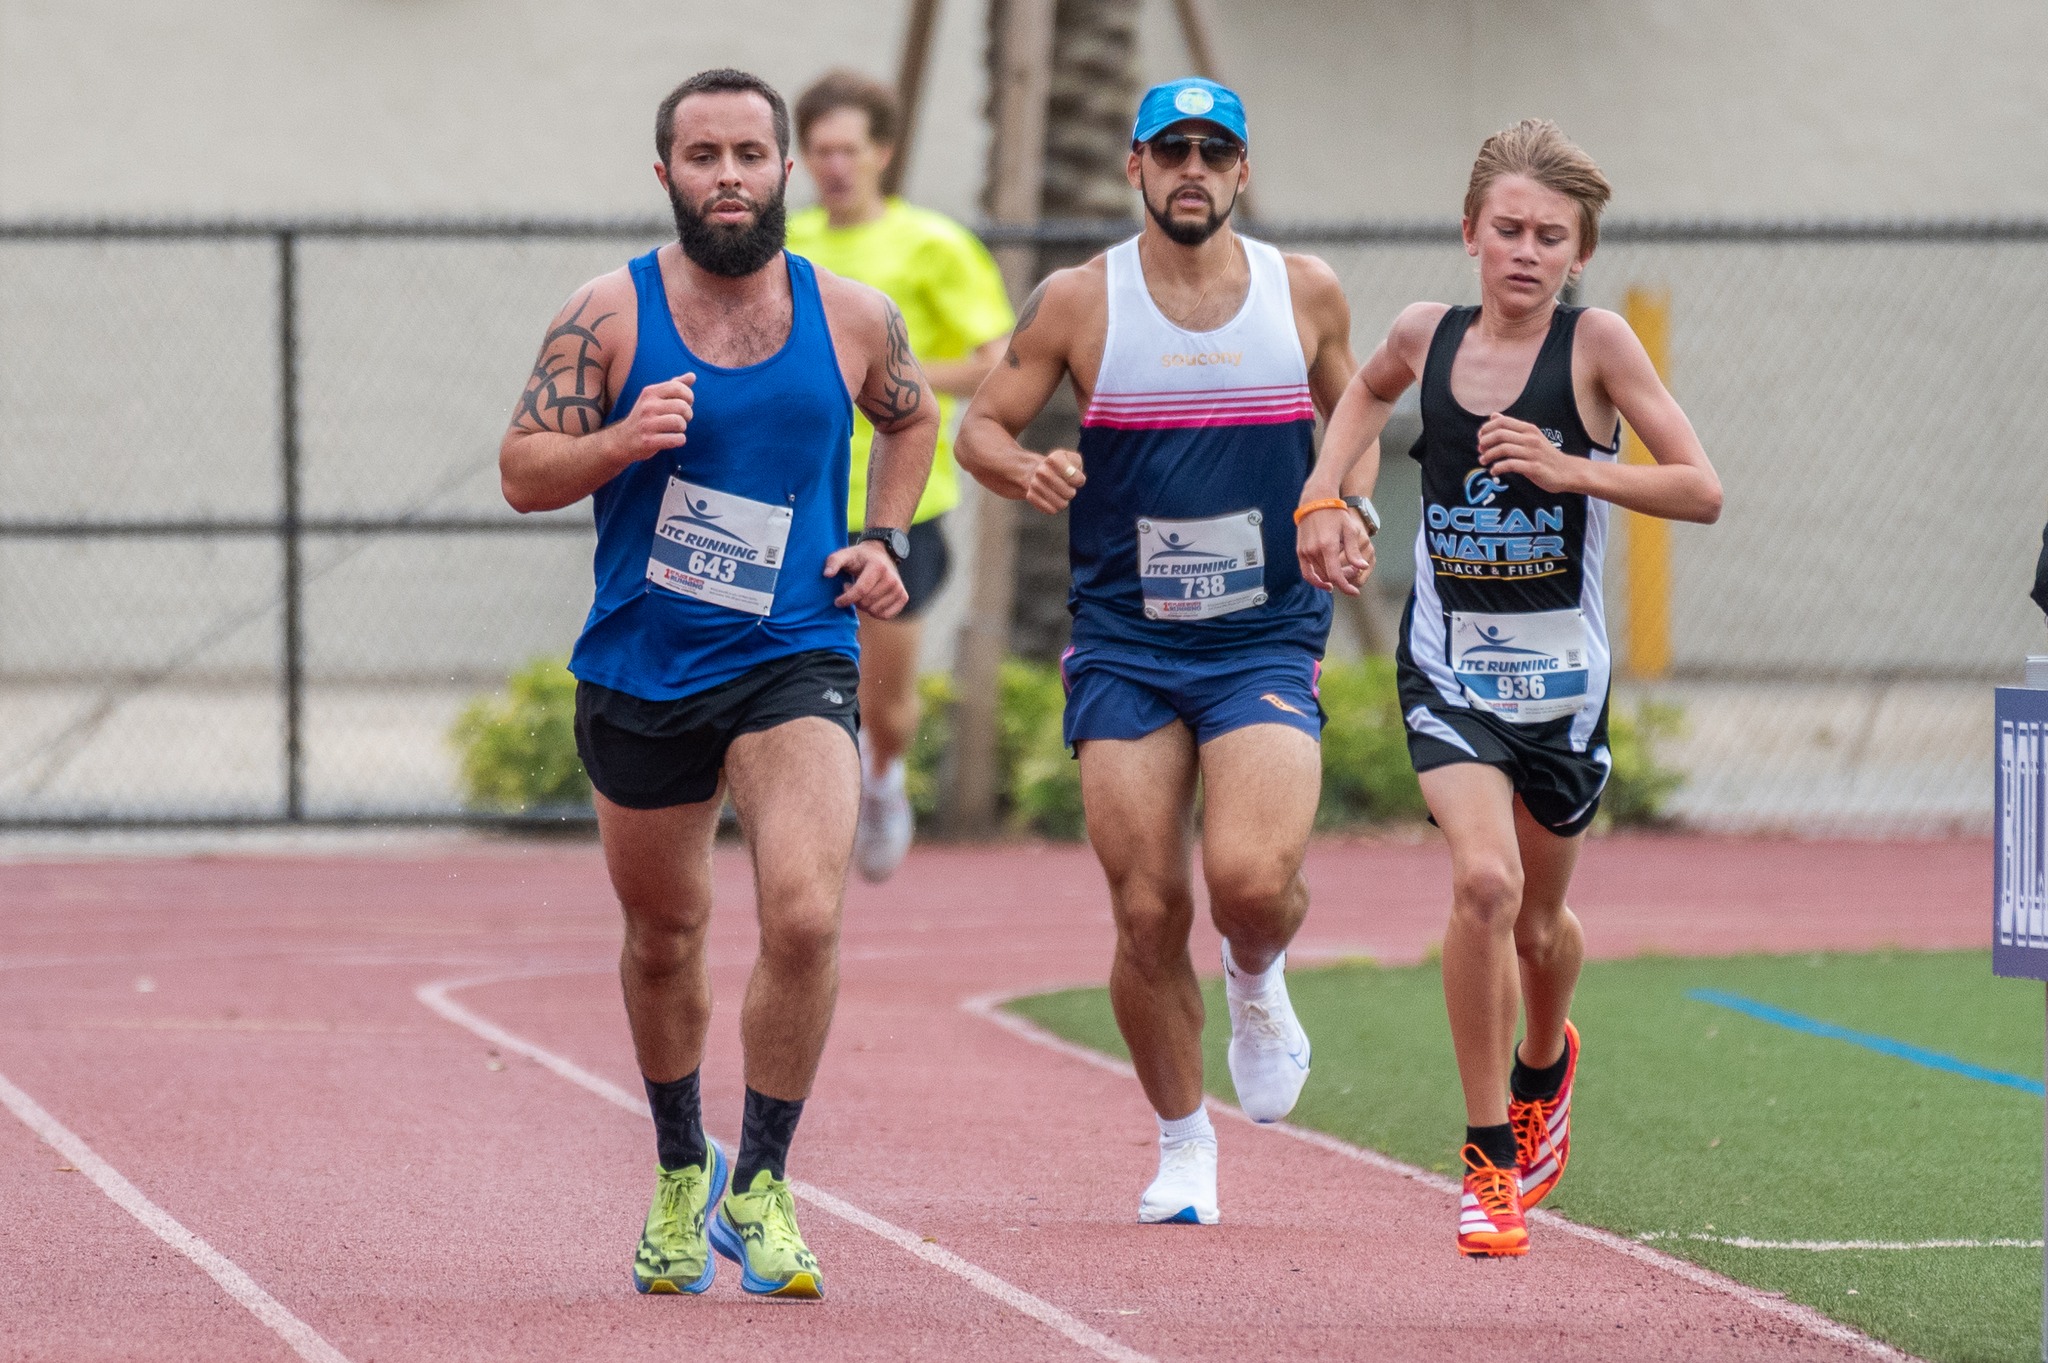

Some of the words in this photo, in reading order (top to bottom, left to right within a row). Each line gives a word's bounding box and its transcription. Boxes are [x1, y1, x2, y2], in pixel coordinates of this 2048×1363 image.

[1161, 351, 1243, 368] saucony
[1427, 503, 1564, 533] OCEAN
[659, 524, 685, 541] JTC
[684, 533, 759, 561] RUNNING
[1428, 531, 1565, 562] WATER
[688, 551, 738, 583] 643
[1145, 564, 1168, 575] JTC
[1171, 558, 1238, 575] RUNNING
[1442, 561, 1482, 575] TRACK
[1491, 566, 1499, 575] &
[1508, 562, 1554, 575] FIELD
[1180, 574, 1226, 599] 738
[1458, 659, 1485, 672] JTC
[1487, 658, 1559, 673] RUNNING
[1497, 675, 1546, 700] 936
